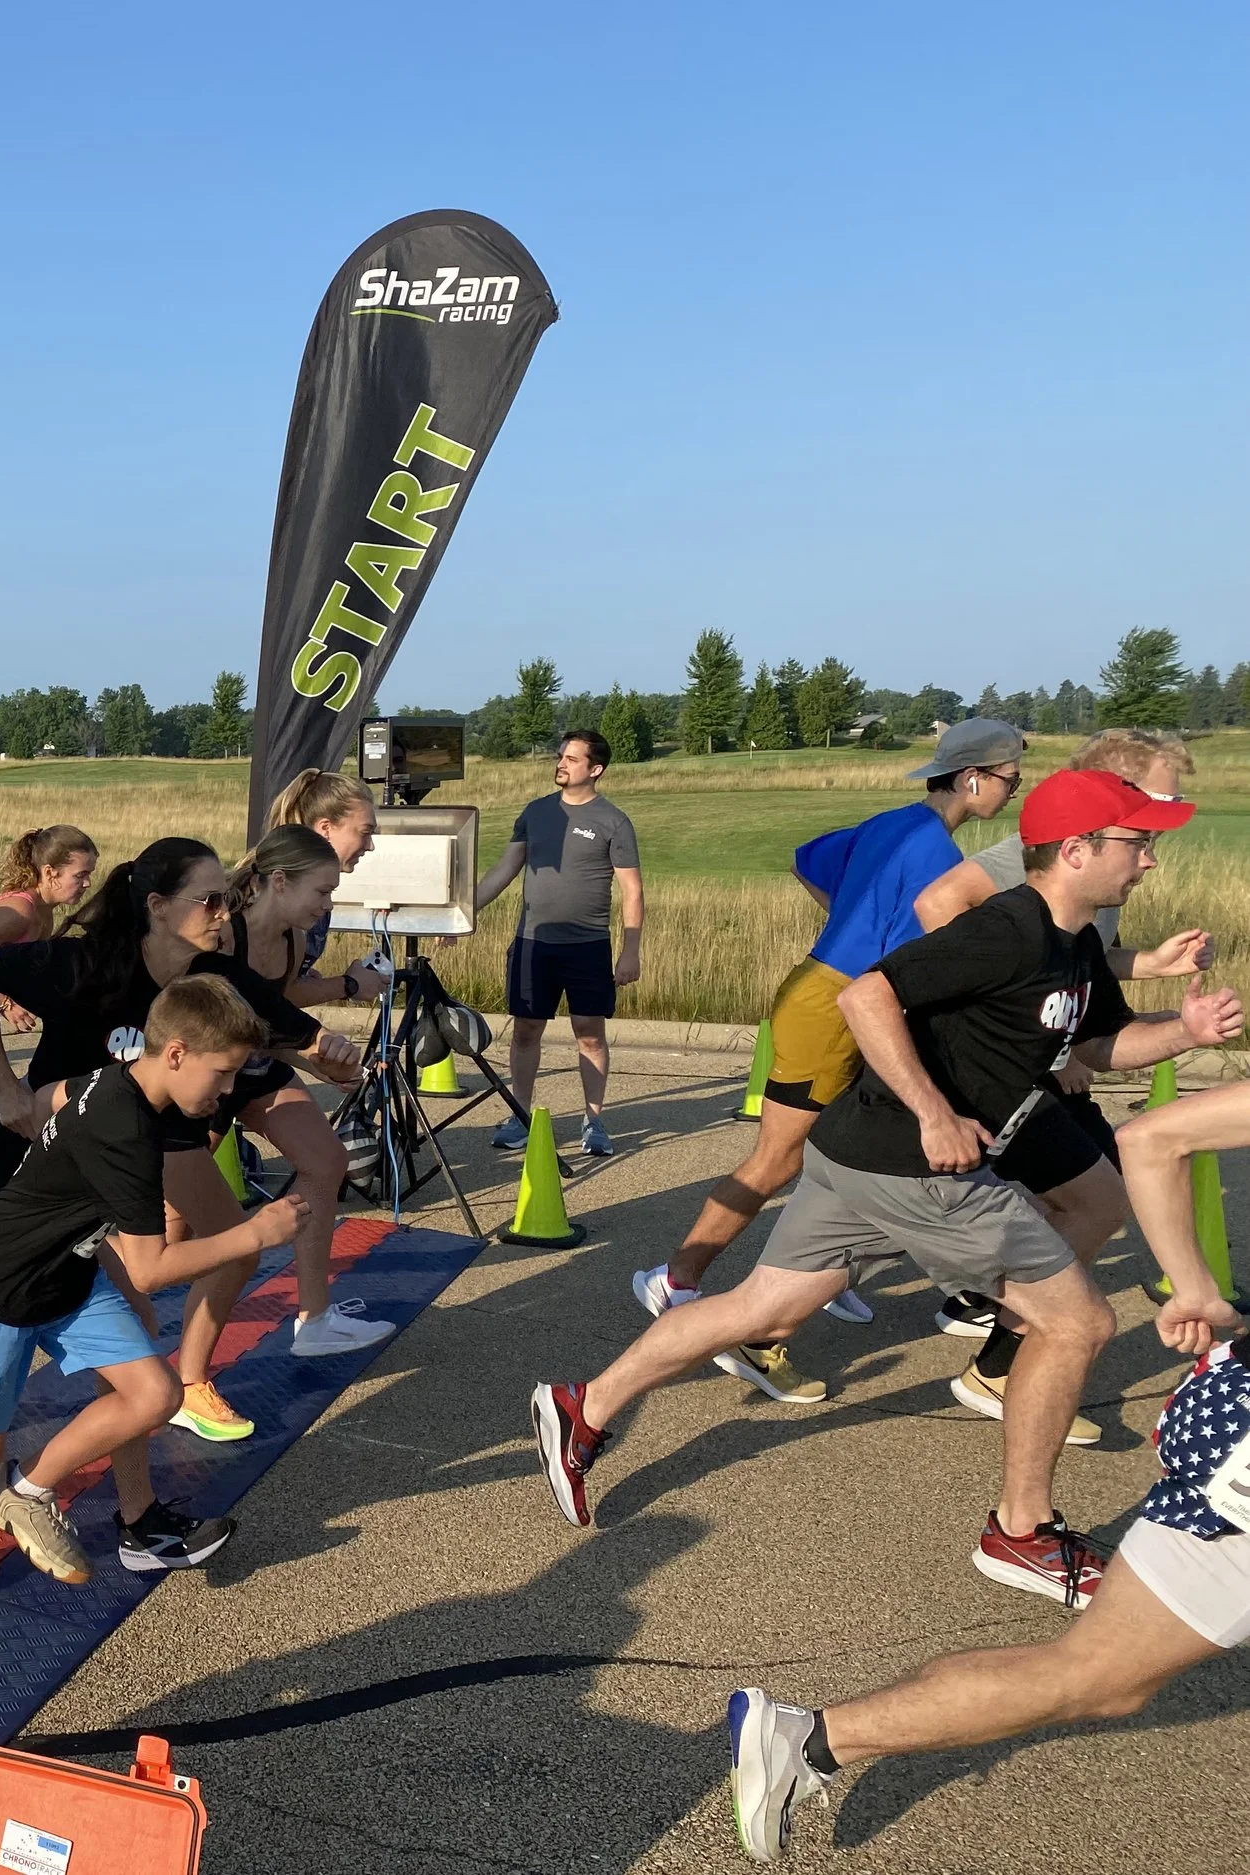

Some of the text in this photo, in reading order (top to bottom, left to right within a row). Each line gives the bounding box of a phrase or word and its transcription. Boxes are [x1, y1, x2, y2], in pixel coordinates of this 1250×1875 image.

[354, 266, 521, 308] ShaZam
[438, 303, 514, 326] racing
[290, 402, 476, 713] START
